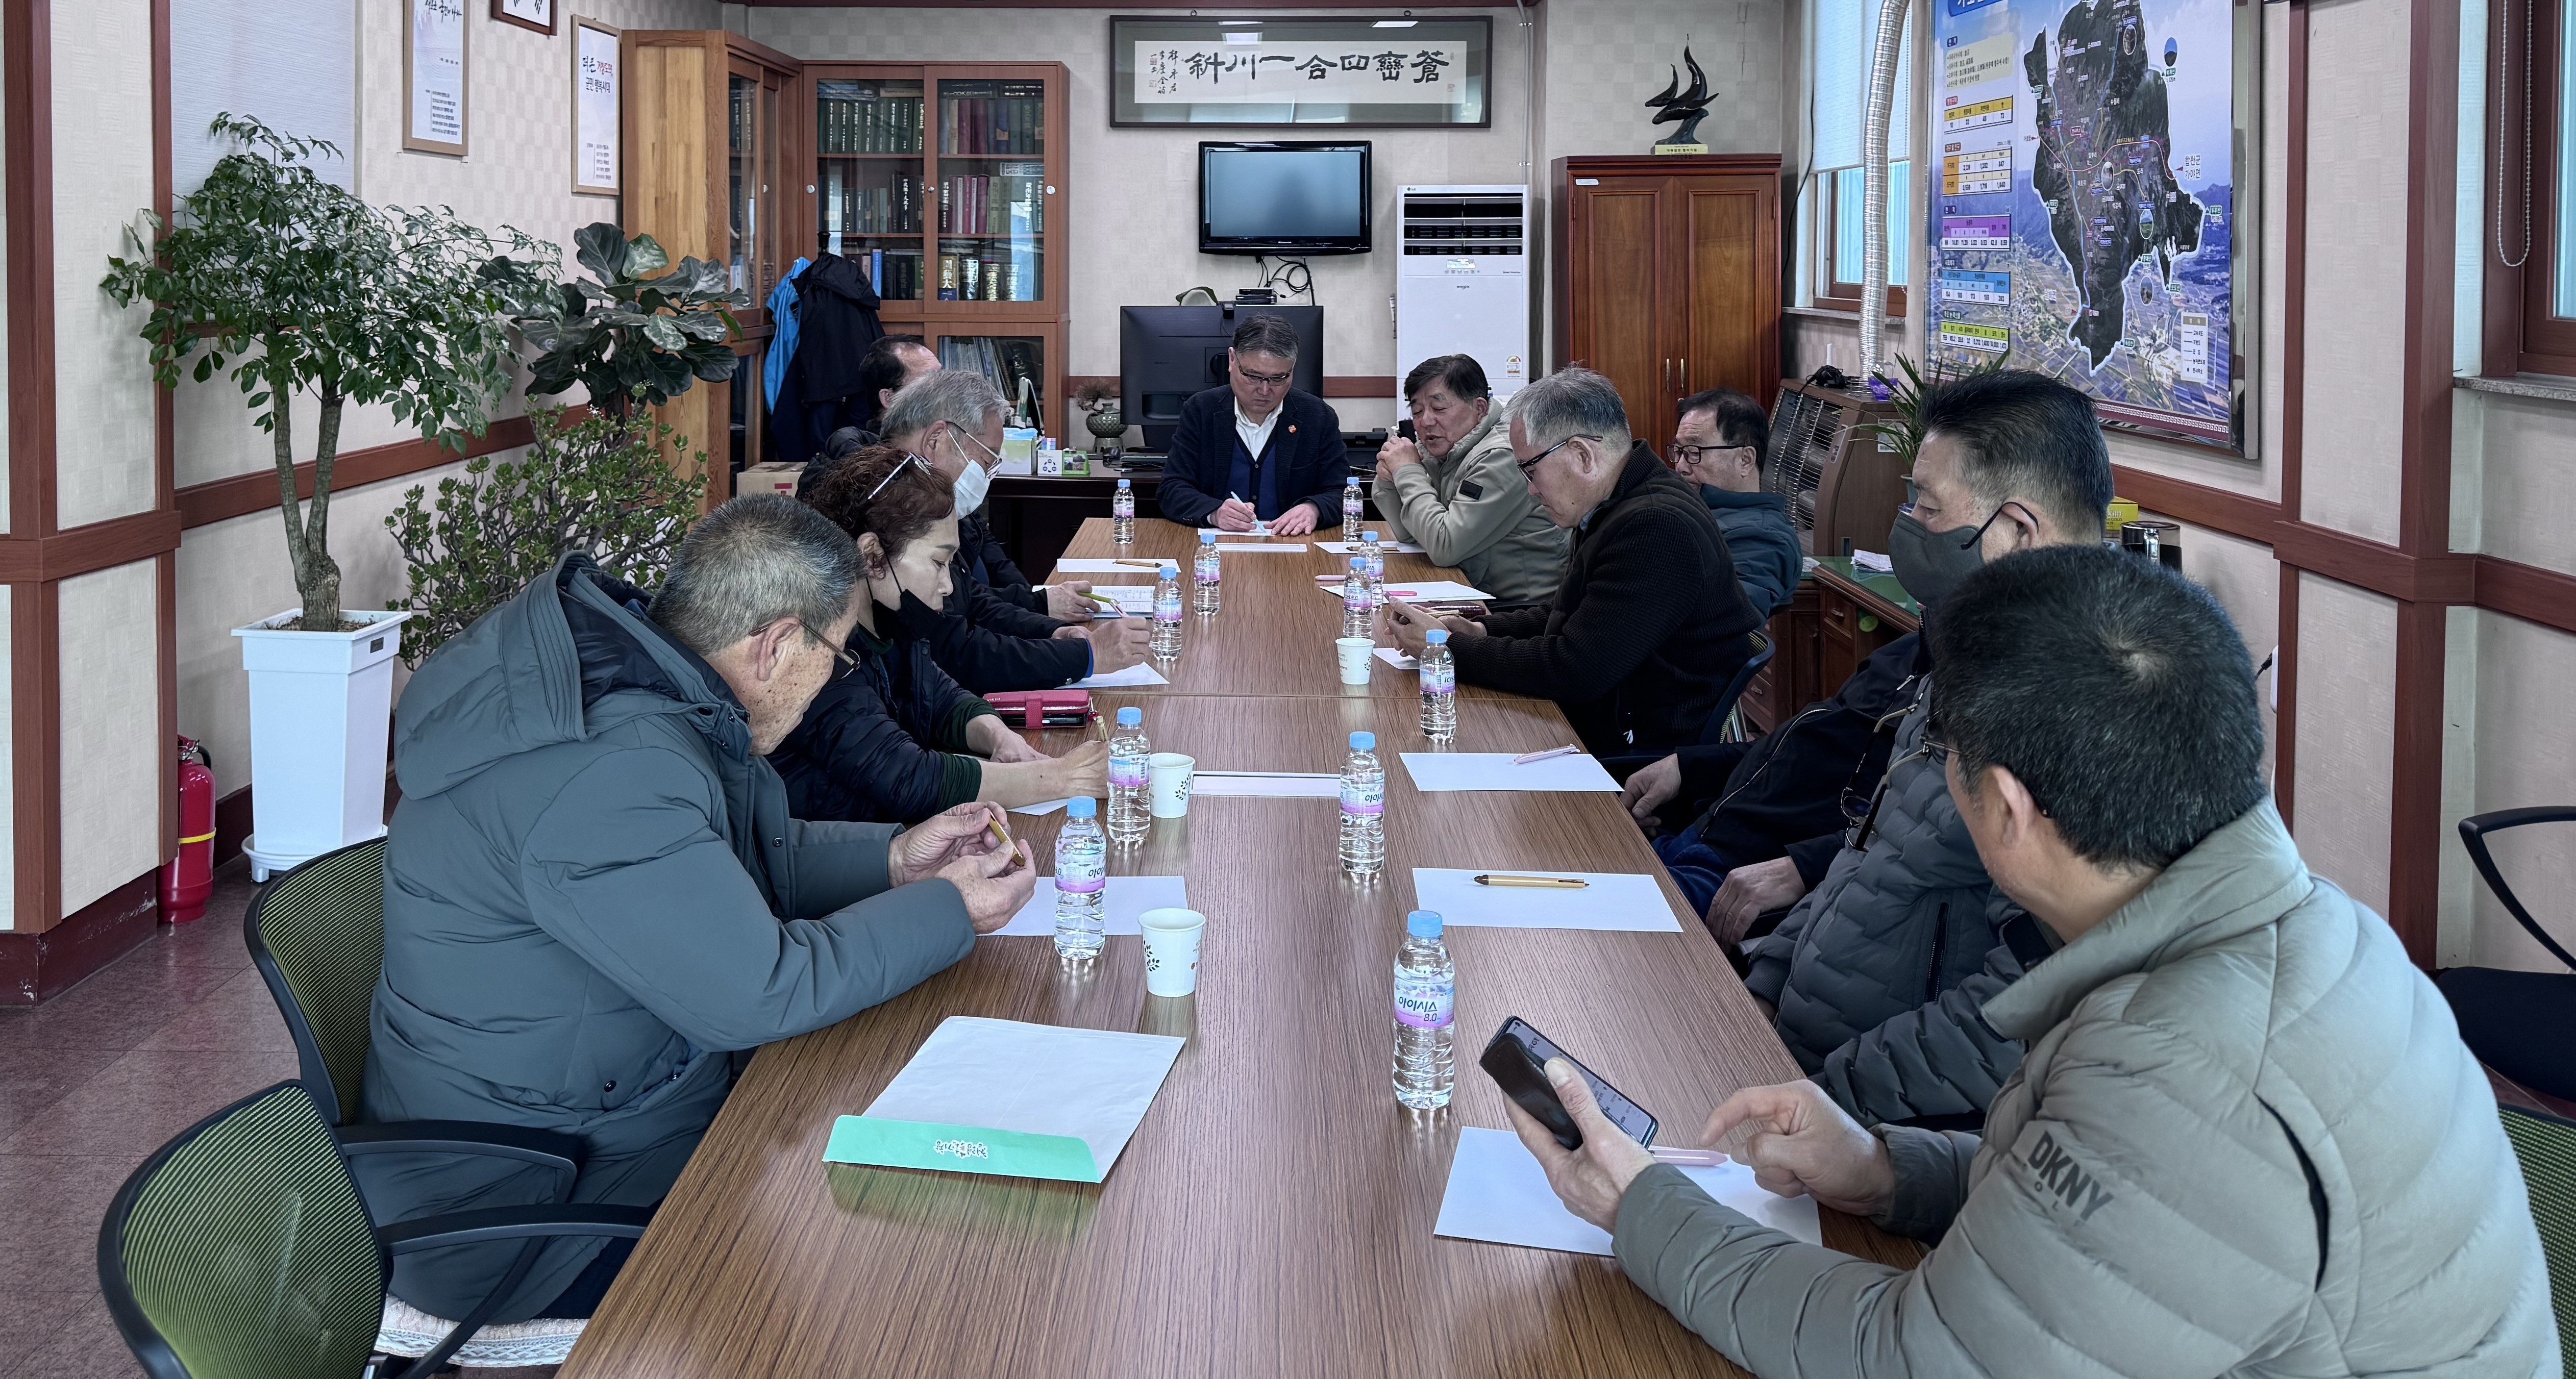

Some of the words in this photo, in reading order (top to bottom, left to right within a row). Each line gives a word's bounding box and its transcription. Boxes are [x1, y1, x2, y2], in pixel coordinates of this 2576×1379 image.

[583, 56, 588, 72] 더
[589, 58, 596, 72] 큰
[586, 78, 594, 91] 군민
[595, 79, 610, 93] 행복시대
[2185, 155, 2200, 166] 합천군
[2185, 169, 2200, 179] 가야면
[1399, 996, 1438, 1013] 아이시스
[1424, 1013, 1437, 1022] 8.0
[2027, 1130, 2114, 1221] DKNY
